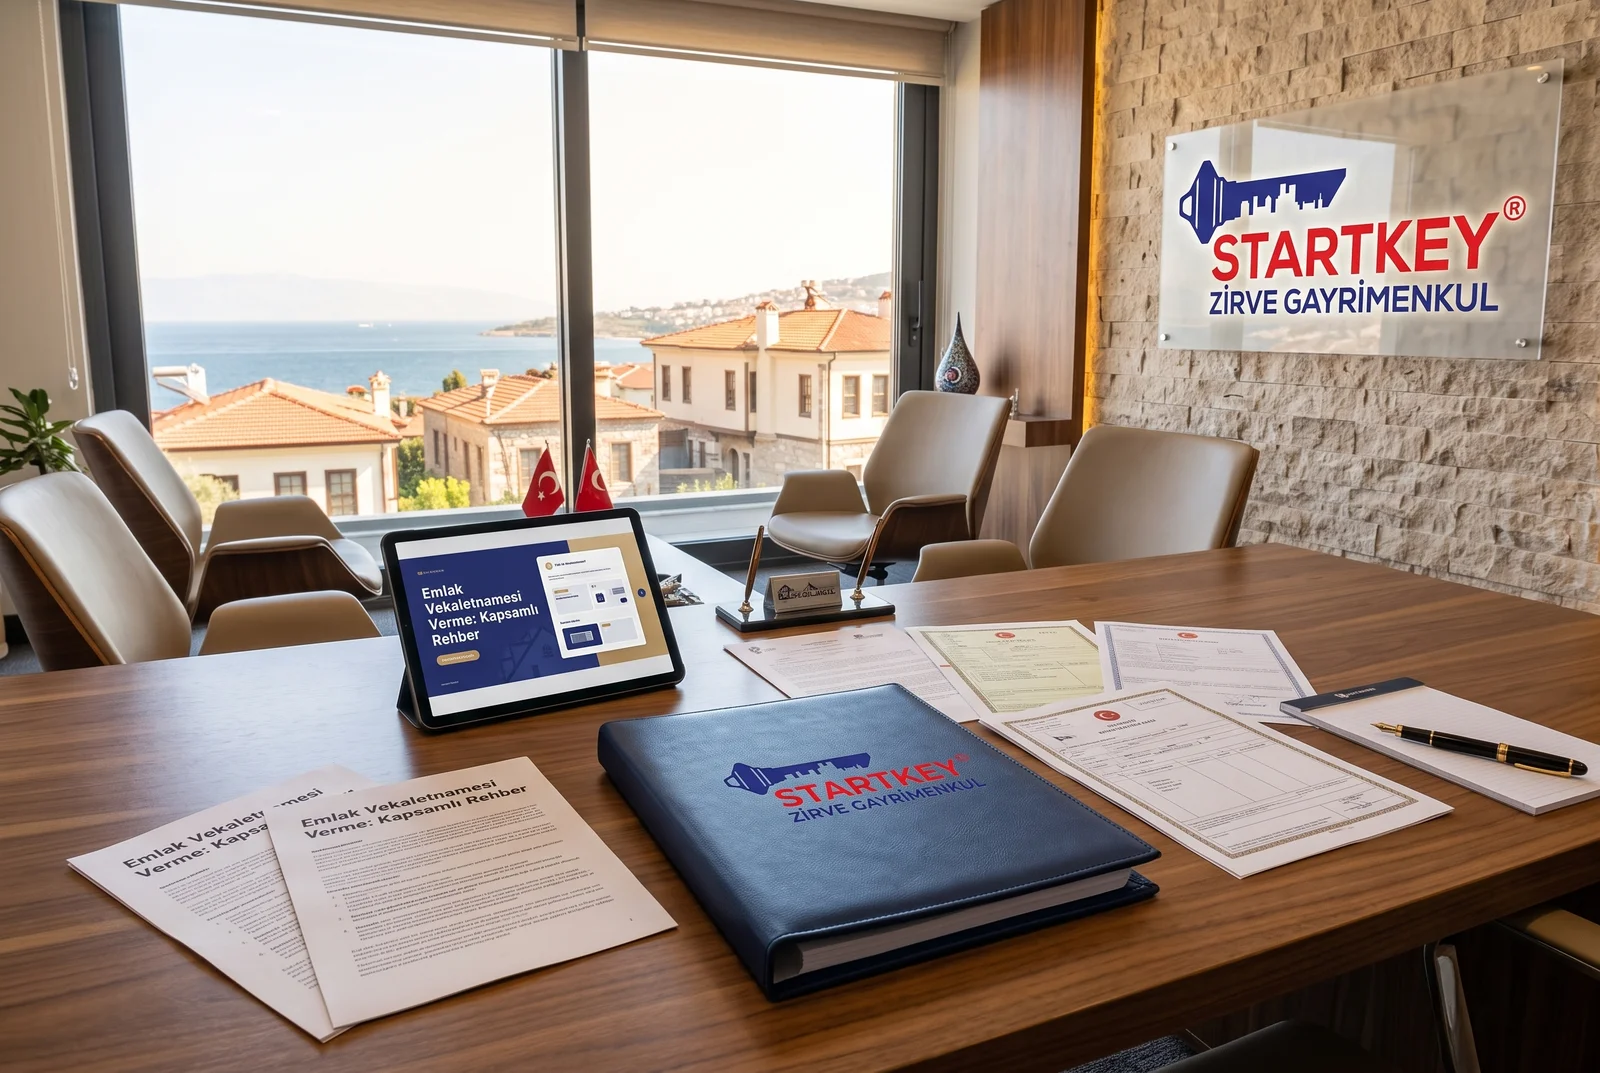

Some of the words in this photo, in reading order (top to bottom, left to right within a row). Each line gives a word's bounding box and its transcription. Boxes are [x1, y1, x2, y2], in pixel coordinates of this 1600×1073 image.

[1211, 212, 1500, 281] STARTKEY
[1209, 284, 1278, 315] ZİRVE
[1283, 279, 1499, 314] GAYRİMENKUL
[421, 583, 464, 600] Emlak
[424, 590, 522, 615] Vekaletnamesi
[428, 615, 477, 630] Verme:
[479, 604, 539, 623] Kapsamlı
[431, 630, 480, 646] Rehber
[301, 809, 361, 828] Emlak
[364, 779, 498, 815] Vekaletnamesi
[774, 759, 960, 808] STARTKEY
[788, 803, 850, 823] ZİRVE
[851, 777, 987, 811] GAYRİMENKUL
[304, 819, 374, 839] Verme:
[377, 800, 463, 825] Kapsamlı
[465, 785, 528, 805] Rehber
[122, 840, 188, 869] Emlak
[135, 847, 211, 877] Verme:
[210, 823, 269, 849] Kapsa
